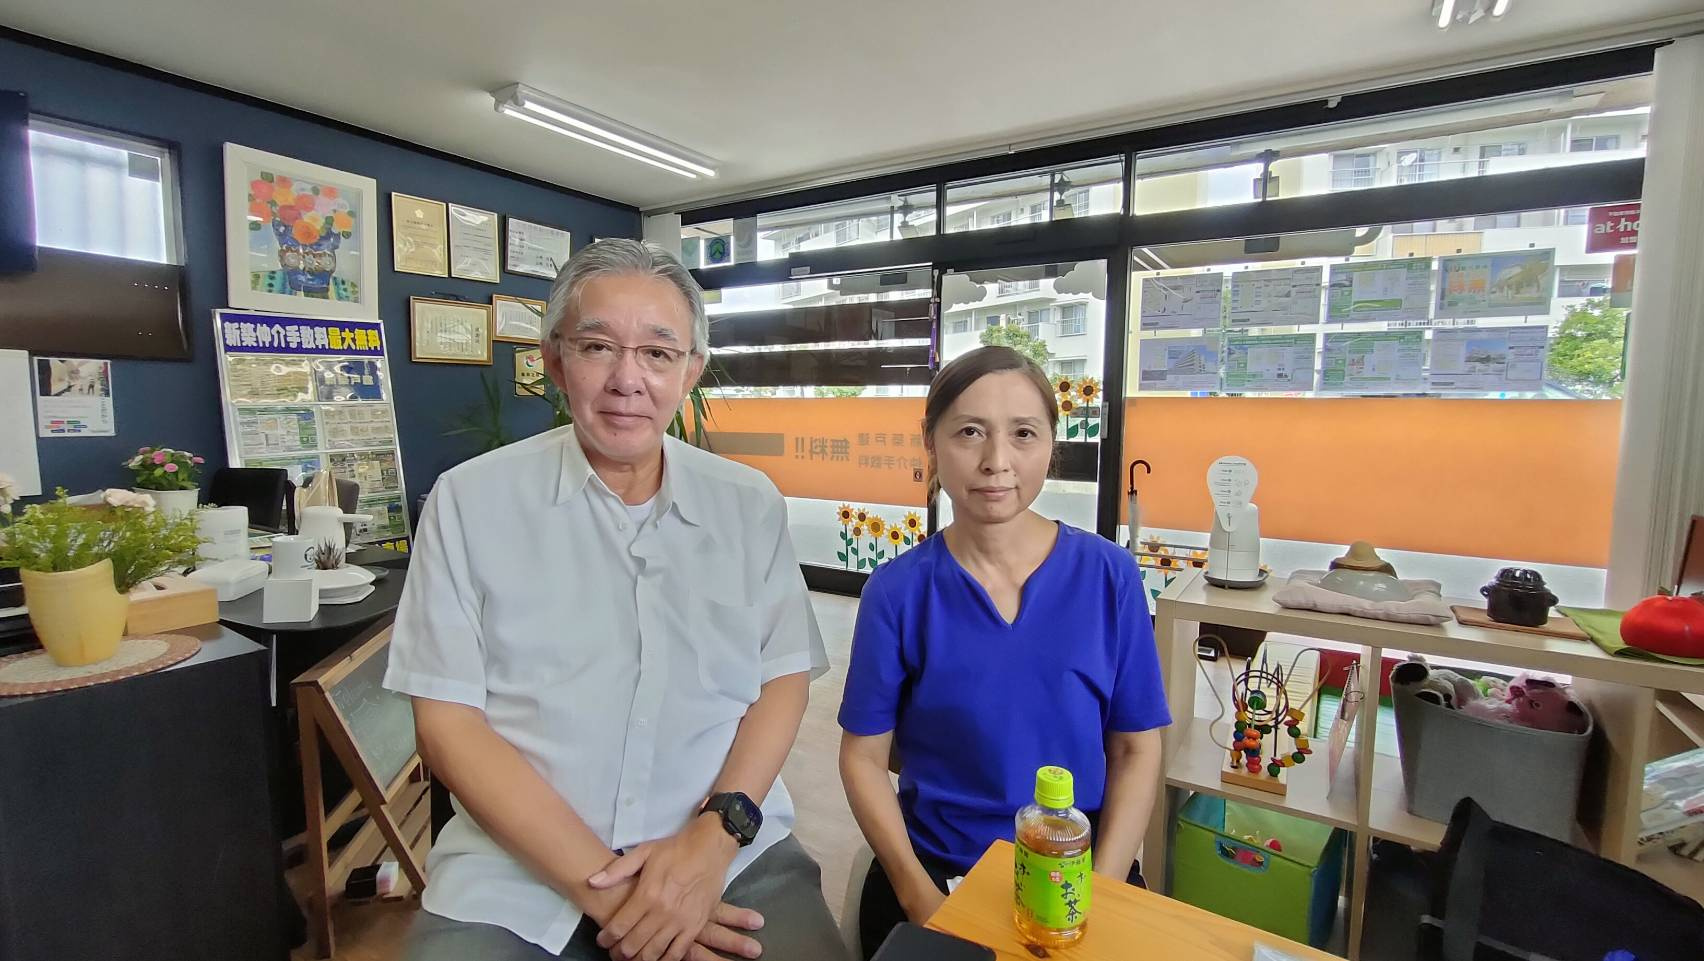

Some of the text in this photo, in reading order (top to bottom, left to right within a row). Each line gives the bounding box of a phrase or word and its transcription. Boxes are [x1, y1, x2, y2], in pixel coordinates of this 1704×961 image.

[1594, 221, 1614, 234] at
[224, 322, 380, 350] 新築仲介手数料最大無料
[1061, 880, 1082, 923] お茶
